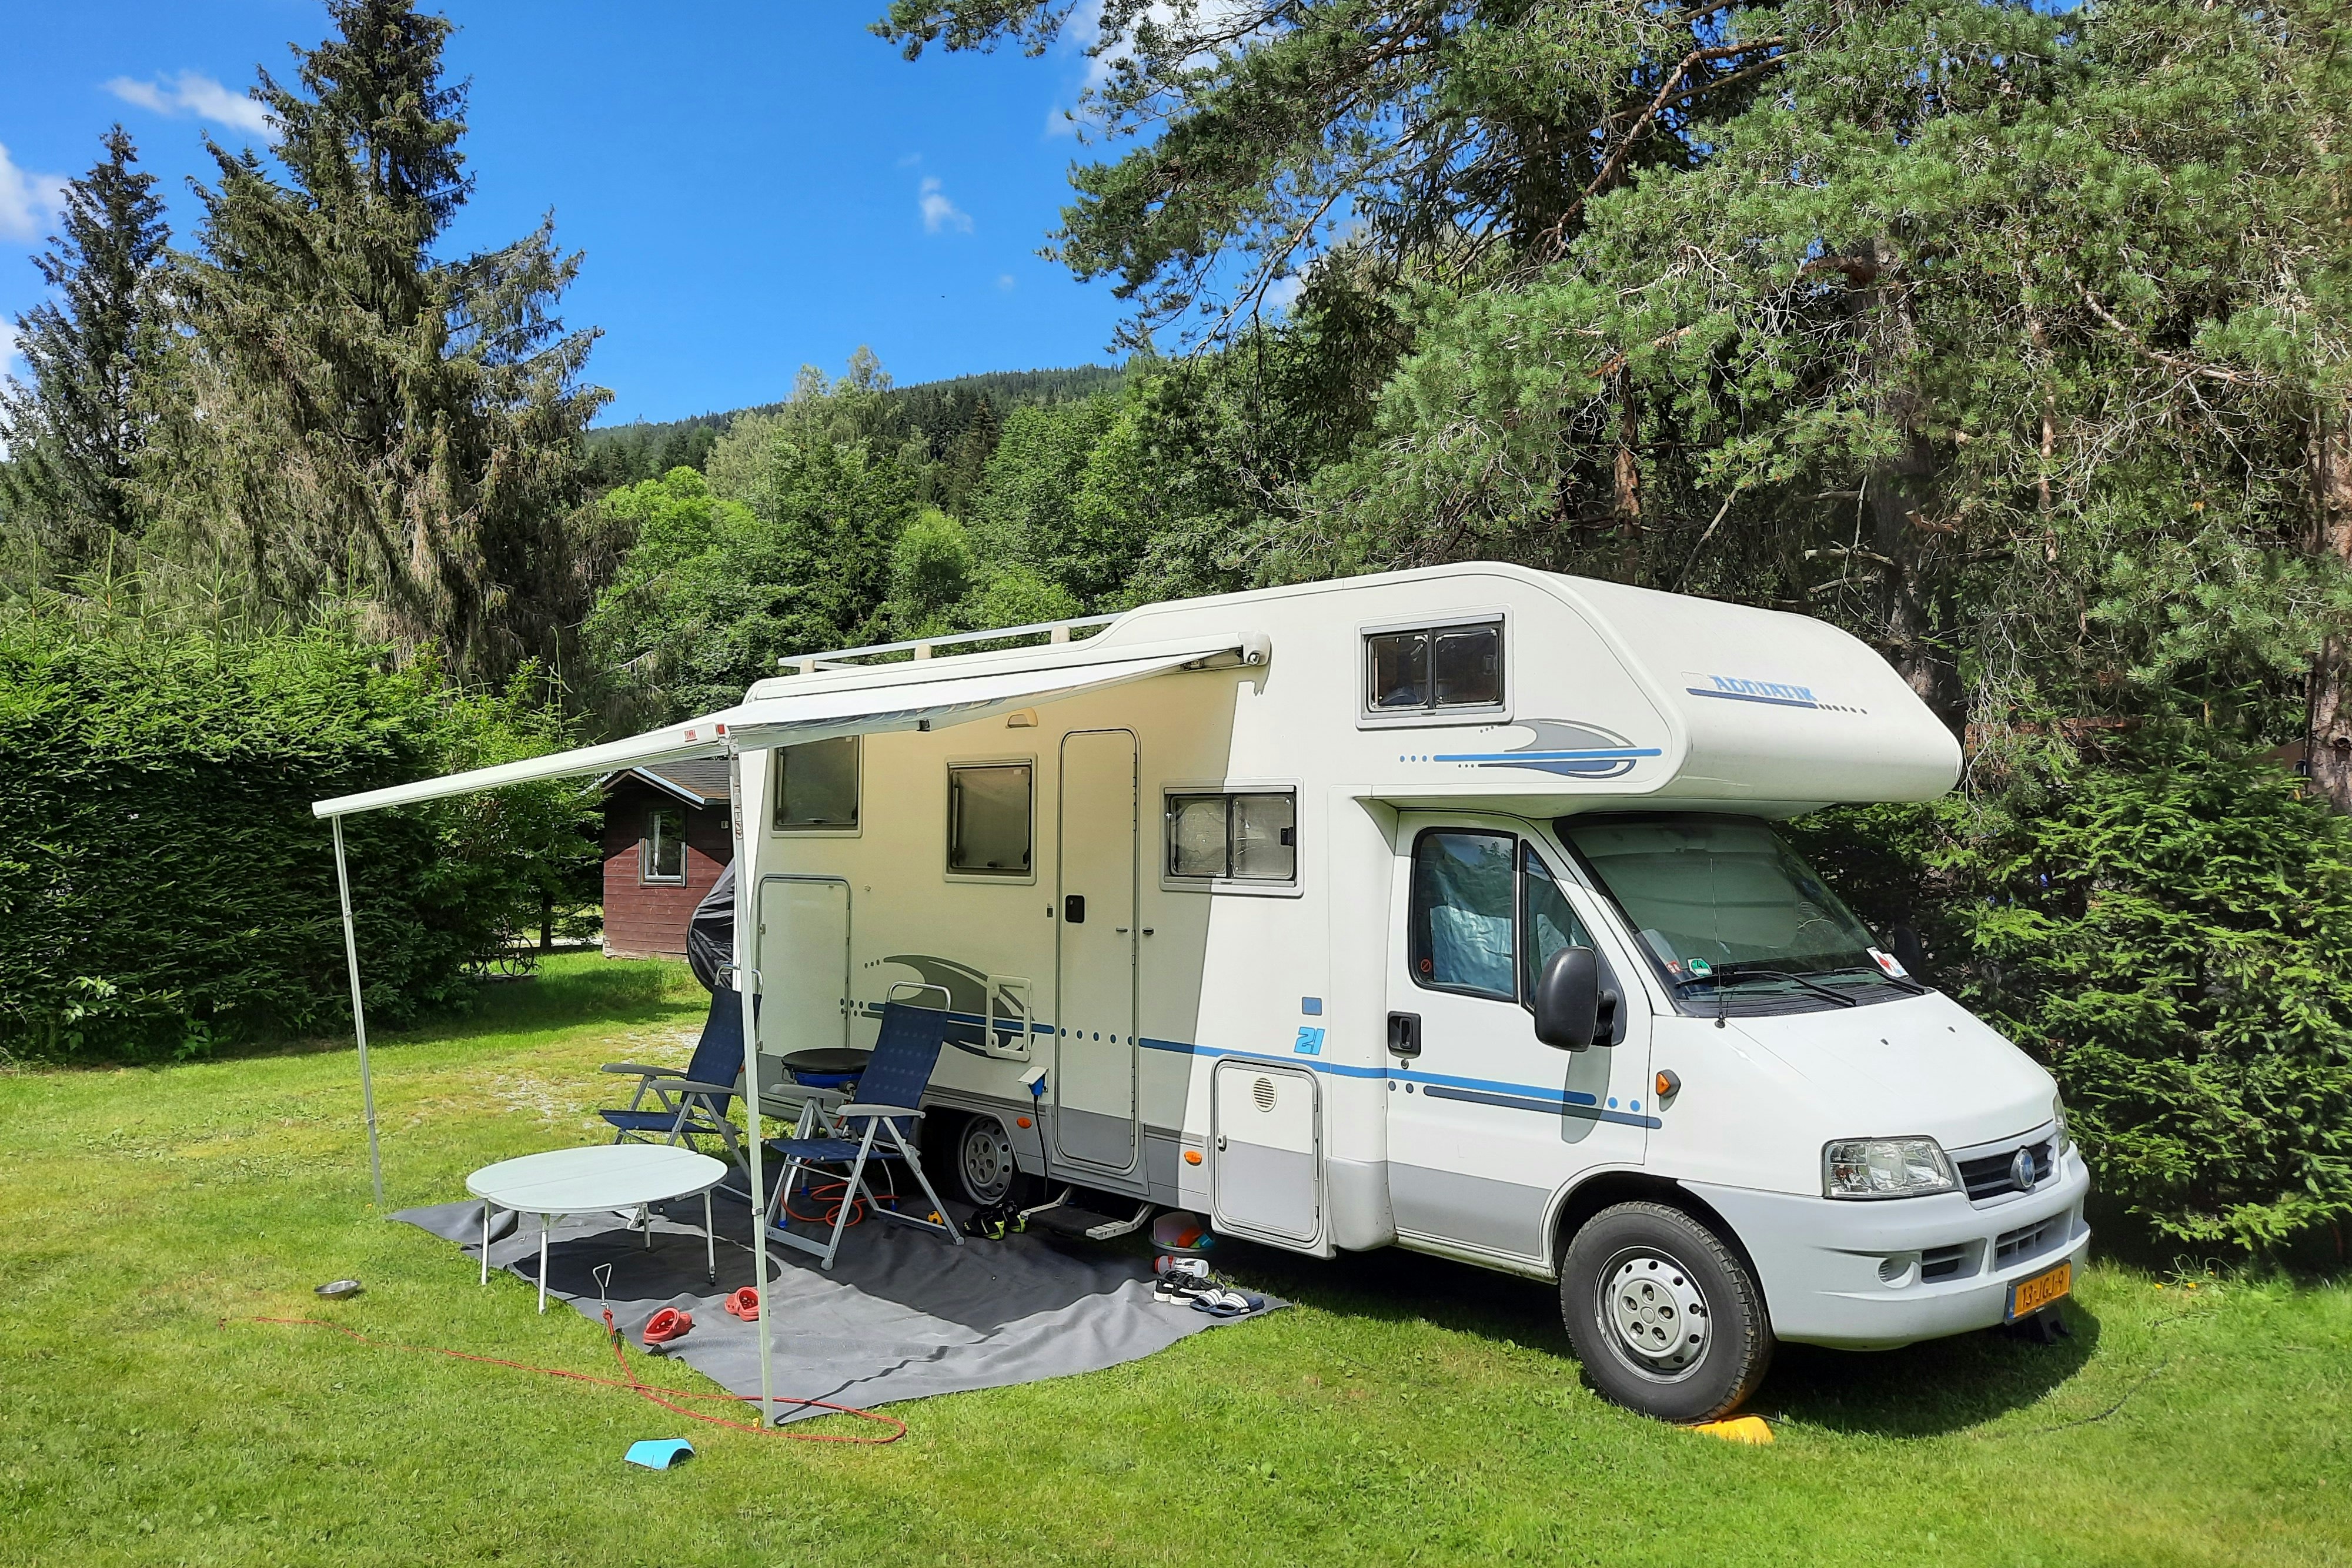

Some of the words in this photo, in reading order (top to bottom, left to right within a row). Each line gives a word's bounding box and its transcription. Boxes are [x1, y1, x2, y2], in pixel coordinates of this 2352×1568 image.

[1708, 674, 1818, 702] ADRIATIK
[1294, 1027, 1325, 1055] 21
[2023, 1270, 2064, 1308] 13-JGJ-9
